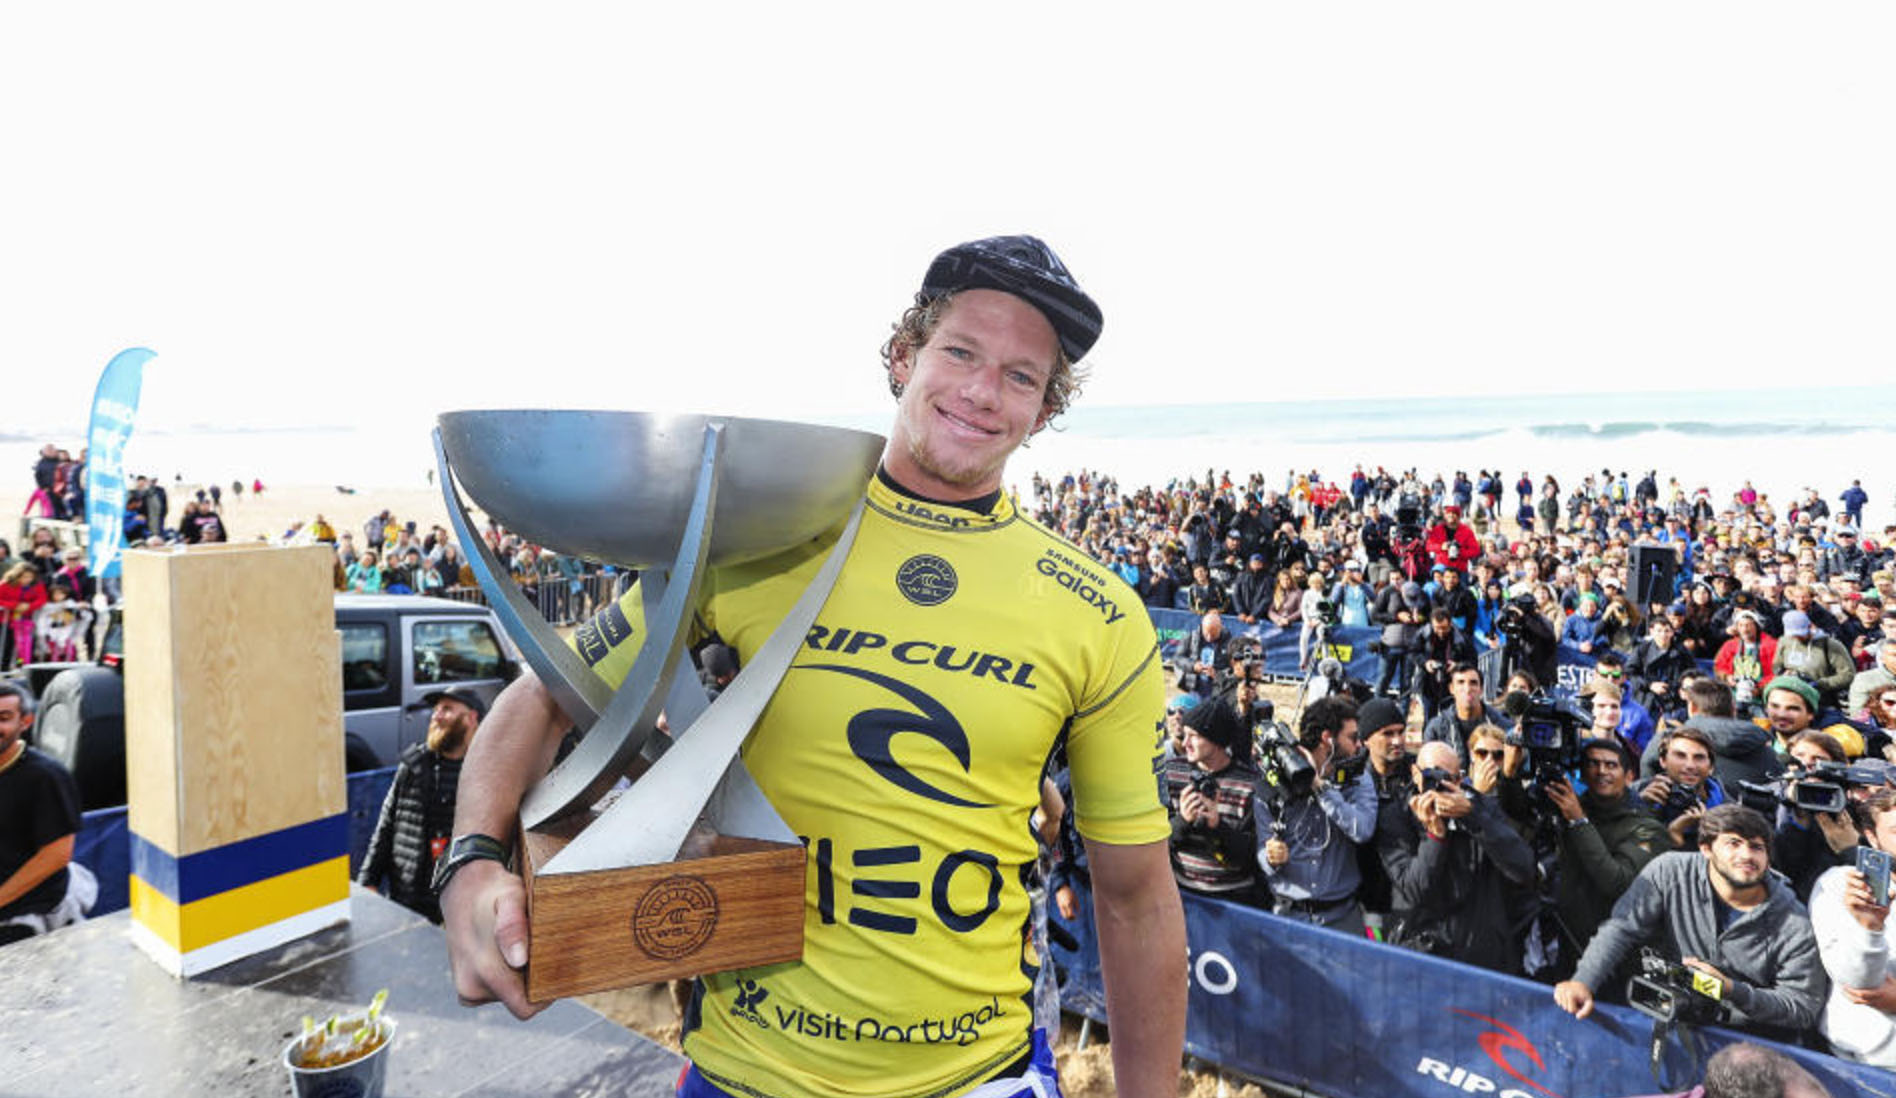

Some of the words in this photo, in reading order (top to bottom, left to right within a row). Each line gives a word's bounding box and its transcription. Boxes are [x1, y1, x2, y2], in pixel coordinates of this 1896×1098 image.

[1036, 558, 1126, 625] Galaxy
[805, 624, 887, 654] RIP
[891, 641, 1037, 690] CURL
[776, 1004, 848, 1041] visit
[856, 995, 1006, 1046] Portugal
[1417, 1056, 1496, 1093] RIP
